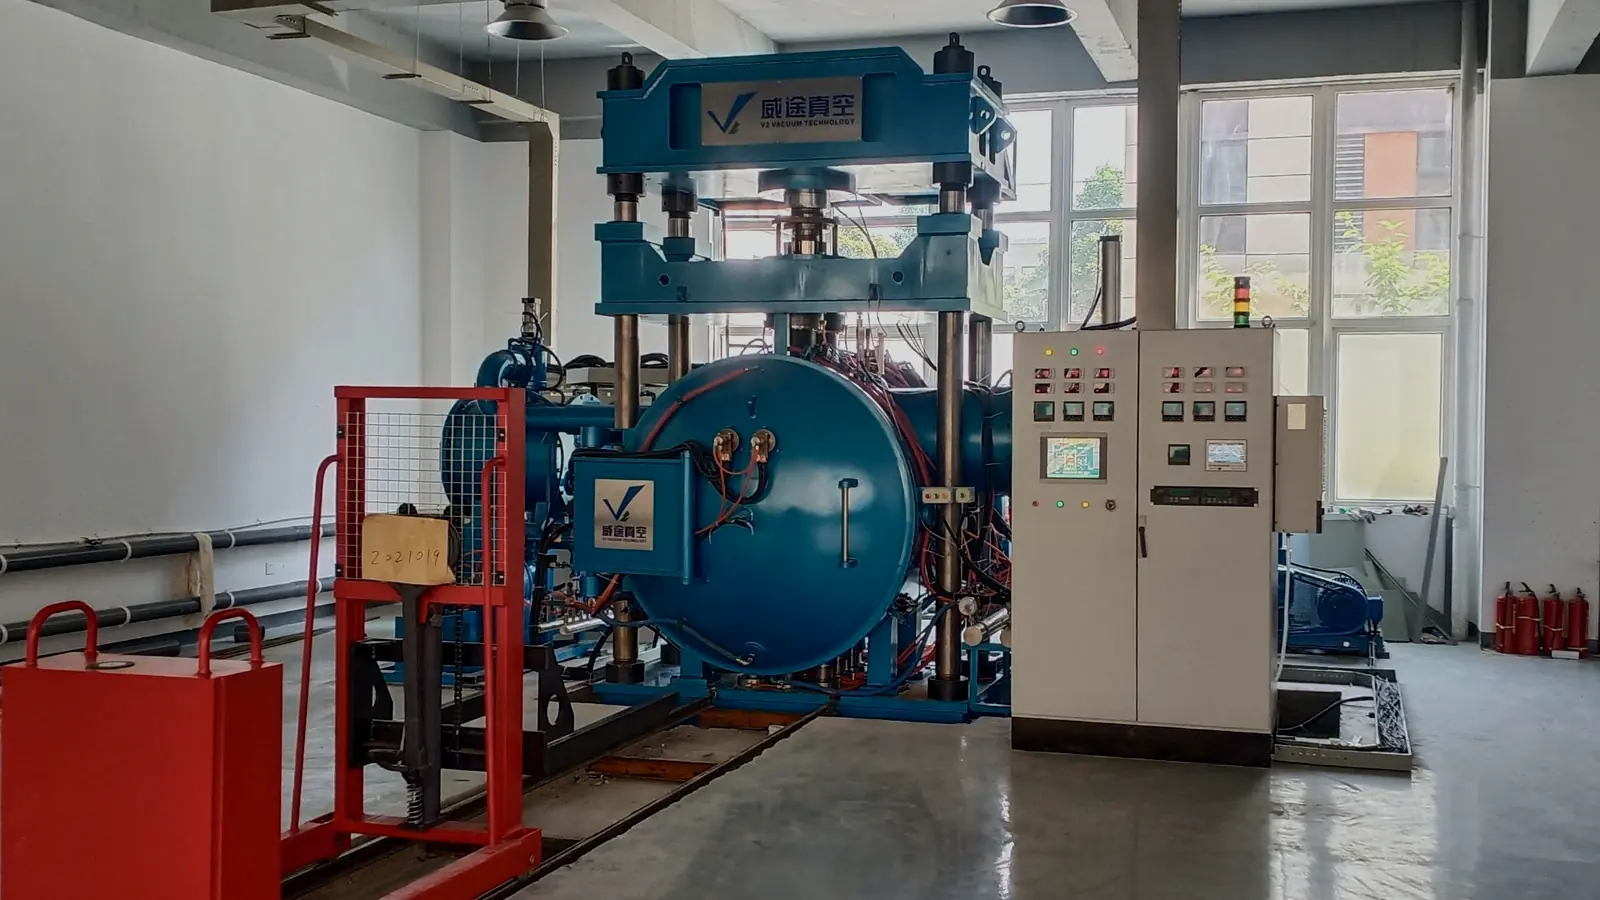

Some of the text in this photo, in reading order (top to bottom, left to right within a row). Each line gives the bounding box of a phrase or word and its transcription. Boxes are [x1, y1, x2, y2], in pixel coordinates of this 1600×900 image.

[761, 94, 855, 119] 威途真空
[772, 120, 803, 128] VACUUM
[804, 118, 855, 127] TECHNOLOGY
[602, 525, 647, 538] 威途真空
[371, 549, 440, 566] 2021019
